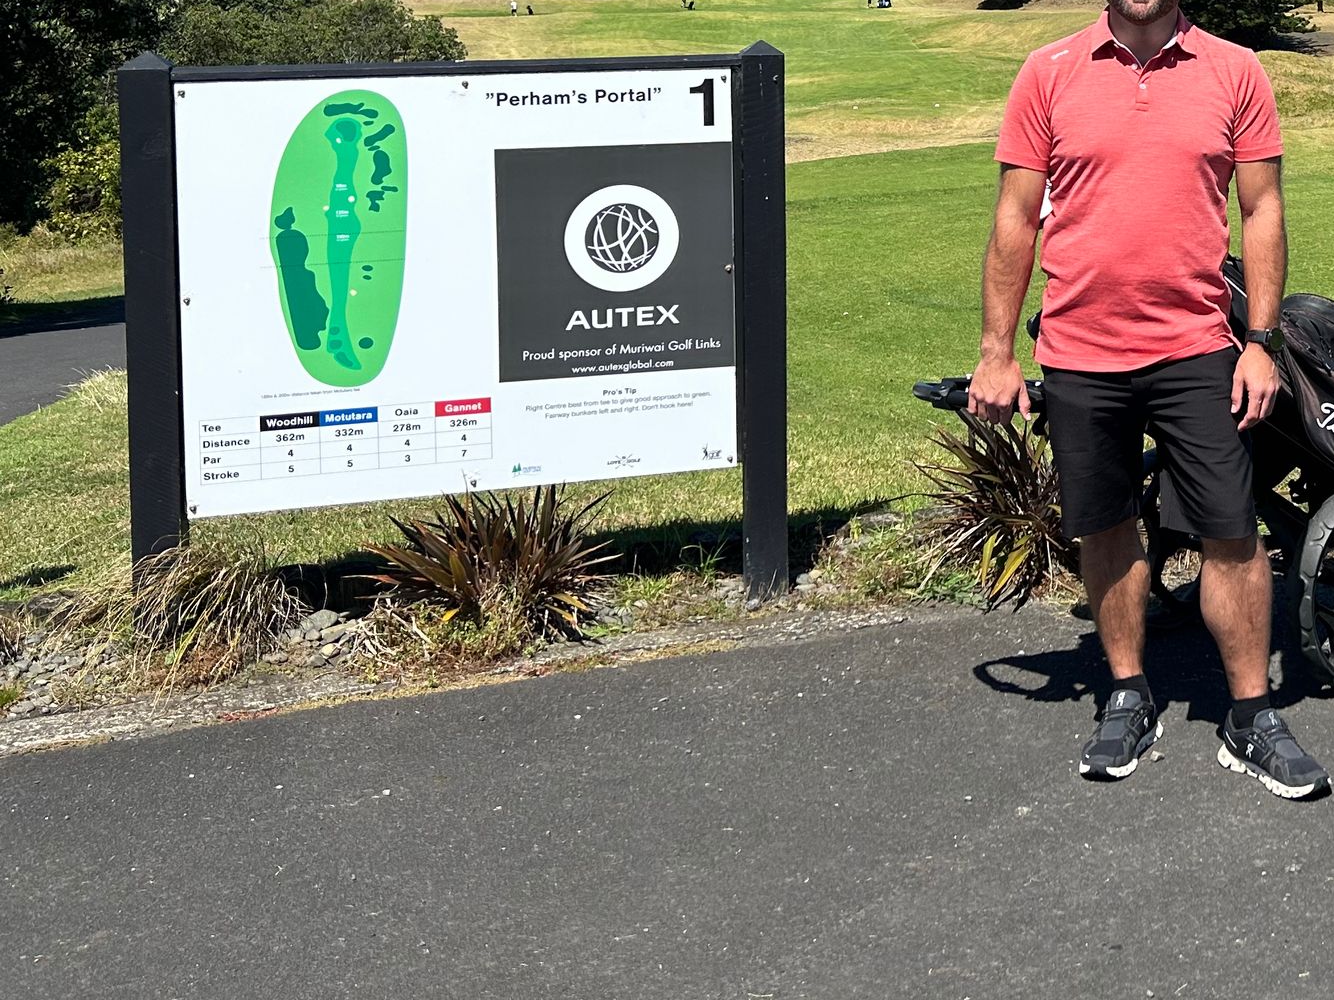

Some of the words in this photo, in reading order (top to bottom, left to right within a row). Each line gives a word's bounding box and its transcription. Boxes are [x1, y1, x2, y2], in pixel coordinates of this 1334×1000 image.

[595, 87, 661, 103] Portal"
[690, 78, 714, 126] 1
[565, 304, 680, 330] AUTEX
[523, 349, 554, 361] Proud
[559, 349, 601, 360] sponsor
[605, 344, 617, 356] of
[620, 342, 665, 354] Muriwai
[668, 339, 693, 351] Golf
[695, 337, 721, 349] Links
[572, 359, 674, 374] www.autexglobal.com
[653, 393, 682, 401] approach
[202, 424, 221, 432] Tee
[266, 416, 313, 427] Woodhill
[325, 410, 373, 422] Motutara
[395, 407, 419, 416] Oaia
[444, 401, 482, 413] Gannet
[571, 409, 597, 417] bunkers
[203, 439, 250, 448] Distance
[276, 432, 305, 443] 362m
[335, 427, 364, 438] 332m
[393, 422, 421, 433] 278m
[449, 417, 478, 428] 326m
[203, 455, 222, 465] Par
[287, 449, 294, 458] 4
[346, 443, 353, 452] 4
[404, 438, 411, 447] 4
[461, 434, 468, 442] 4
[203, 471, 239, 480] Stroke
[288, 465, 295, 474] 5
[347, 459, 353, 468] 5
[405, 454, 411, 463] 3
[461, 450, 468, 458] 7
